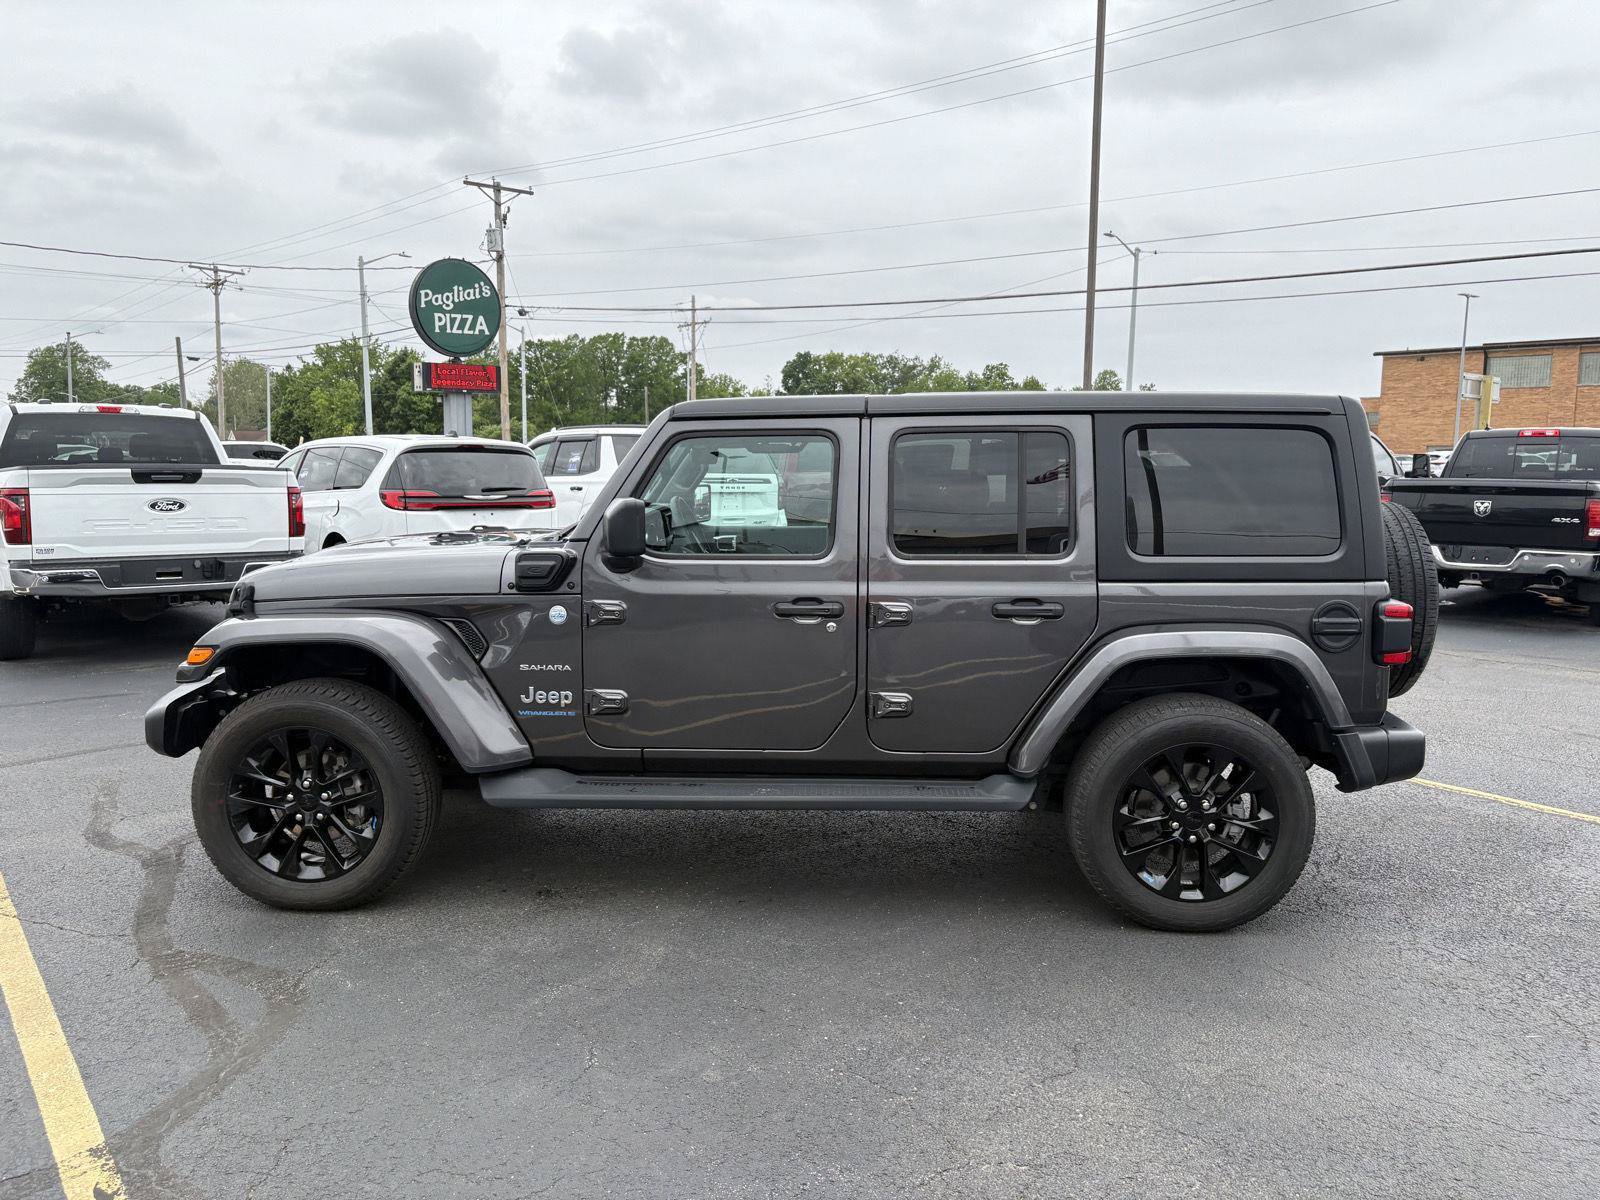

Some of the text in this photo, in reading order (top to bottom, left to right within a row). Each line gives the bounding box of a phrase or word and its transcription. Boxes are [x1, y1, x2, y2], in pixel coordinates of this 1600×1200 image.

[420, 281, 491, 310] Pagliai's
[434, 313, 490, 335] PIZZA
[432, 378, 475, 387] Legendary
[154, 500, 181, 512] Ford
[520, 686, 573, 707] Jeep
